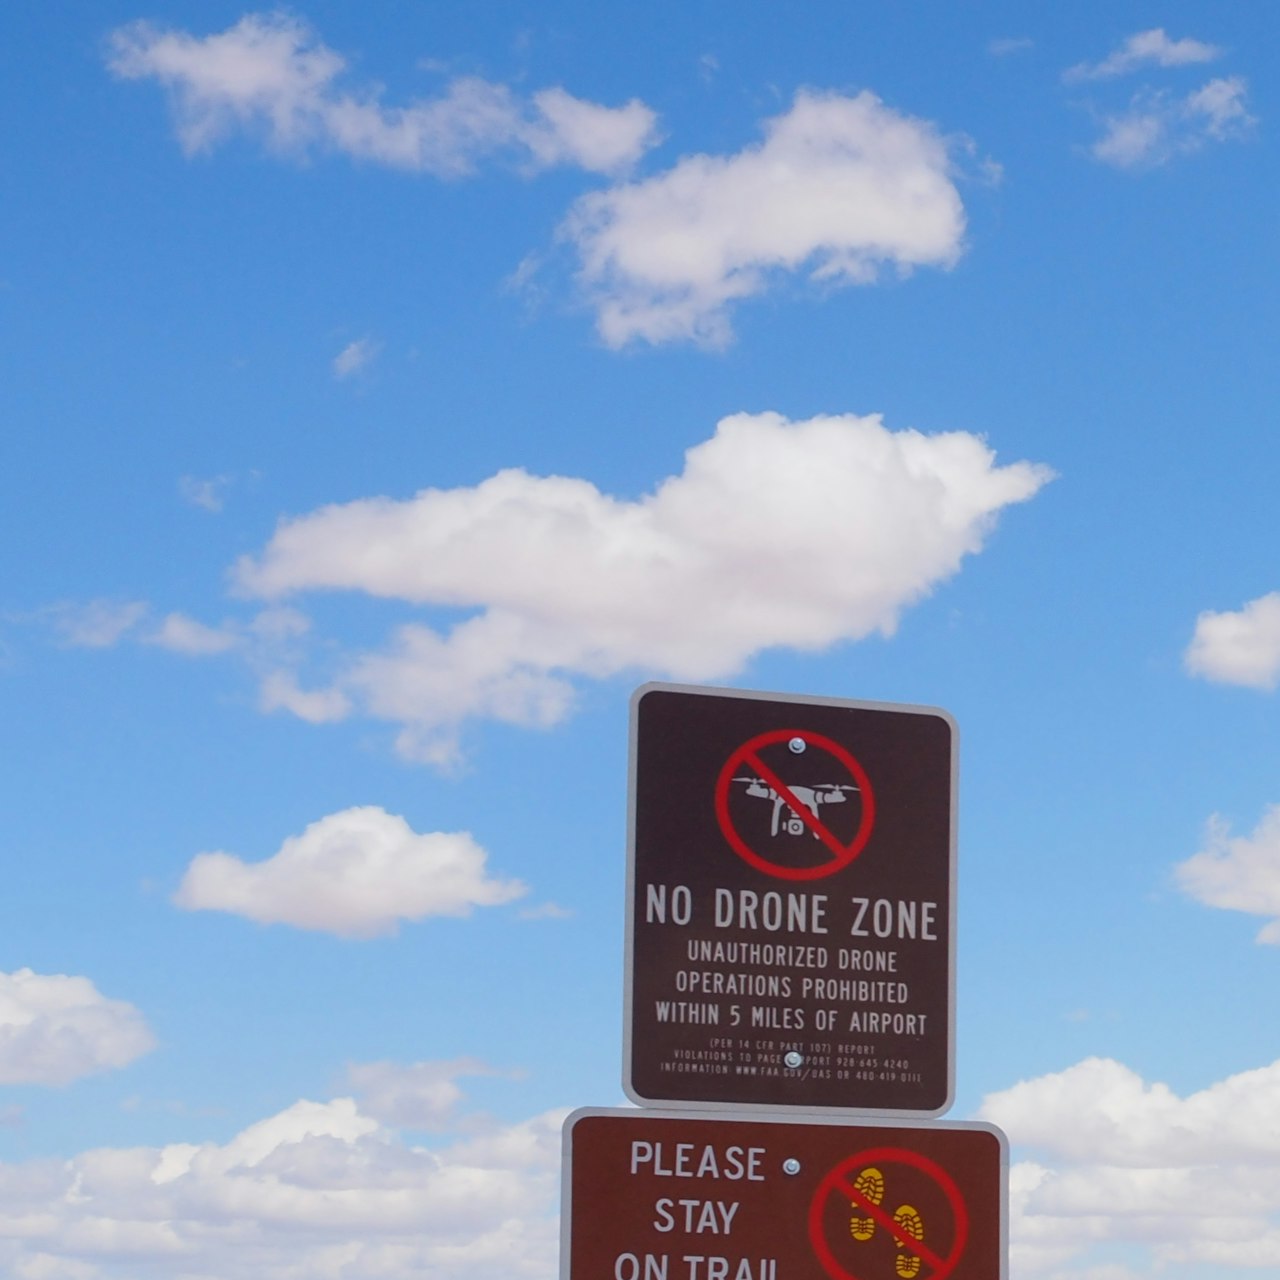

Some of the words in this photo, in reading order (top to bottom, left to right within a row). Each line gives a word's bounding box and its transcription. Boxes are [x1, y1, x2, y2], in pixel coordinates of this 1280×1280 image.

[646, 884, 692, 925] NO
[714, 888, 829, 934] DRONE
[850, 897, 938, 941] ZONE
[687, 940, 828, 969] UNAUTHORIZED
[838, 949, 898, 973] DRONE
[676, 970, 792, 998] OPERATIONS
[802, 978, 908, 1004] PROHIBITED
[656, 1001, 719, 1026] WITHIN
[729, 1005, 741, 1027] 5
[751, 1006, 805, 1030] MILES
[815, 1010, 838, 1032] OF
[849, 1012, 927, 1036] AIRPORT
[674, 1049, 733, 1062] VIOLATIONS
[740, 1053, 752, 1063] TO
[757, 1053, 782, 1064] PAGE
[709, 1038, 733, 1049] (PER
[739, 1040, 750, 1049] 14
[756, 1040, 774, 1051] CFR
[780, 1041, 804, 1052] PART
[810, 1043, 832, 1054] 107)
[838, 1044, 875, 1055] REPORT
[837, 1070, 850, 1080] OR
[630, 1141, 766, 1182] PLEASE
[653, 1198, 740, 1235] STAY
